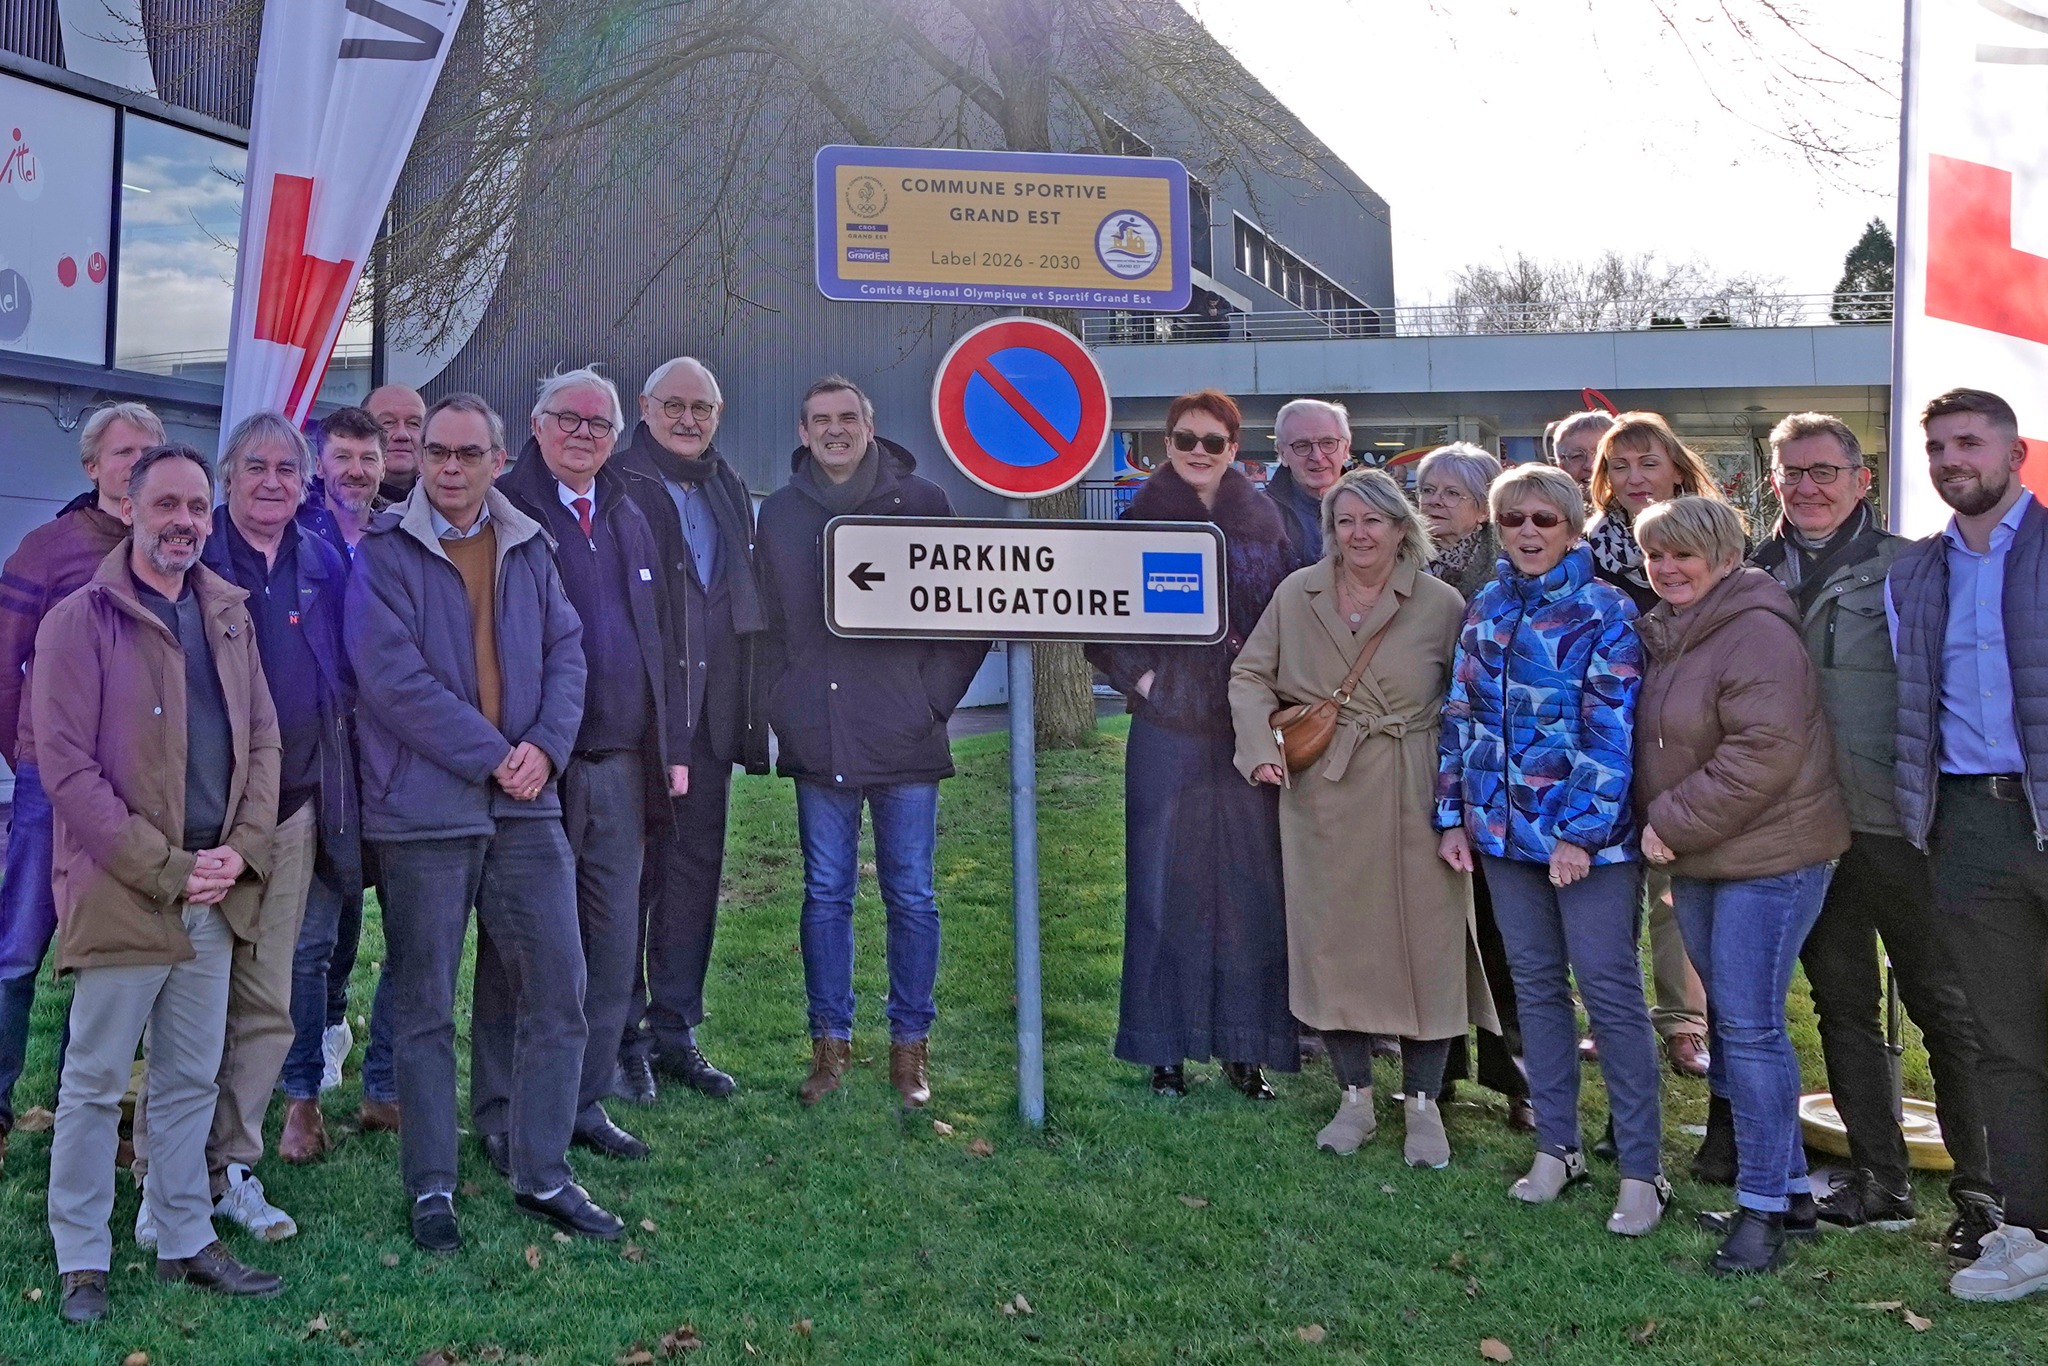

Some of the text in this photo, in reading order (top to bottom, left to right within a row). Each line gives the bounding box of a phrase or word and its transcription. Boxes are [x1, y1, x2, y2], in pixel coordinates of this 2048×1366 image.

[901, 178, 1107, 200] COMMUNE SPORTIVE
[949, 207, 1061, 225] GRAND EST
[931, 250, 977, 266] Label
[982, 252, 1023, 268] 2026
[1039, 254, 1081, 270] 2030
[860, 284, 1152, 304] Comité Régional Olympique et Sportif Grand Est
[909, 543, 1055, 572] PARKING
[909, 586, 1131, 616] OBLIGATOIRE
